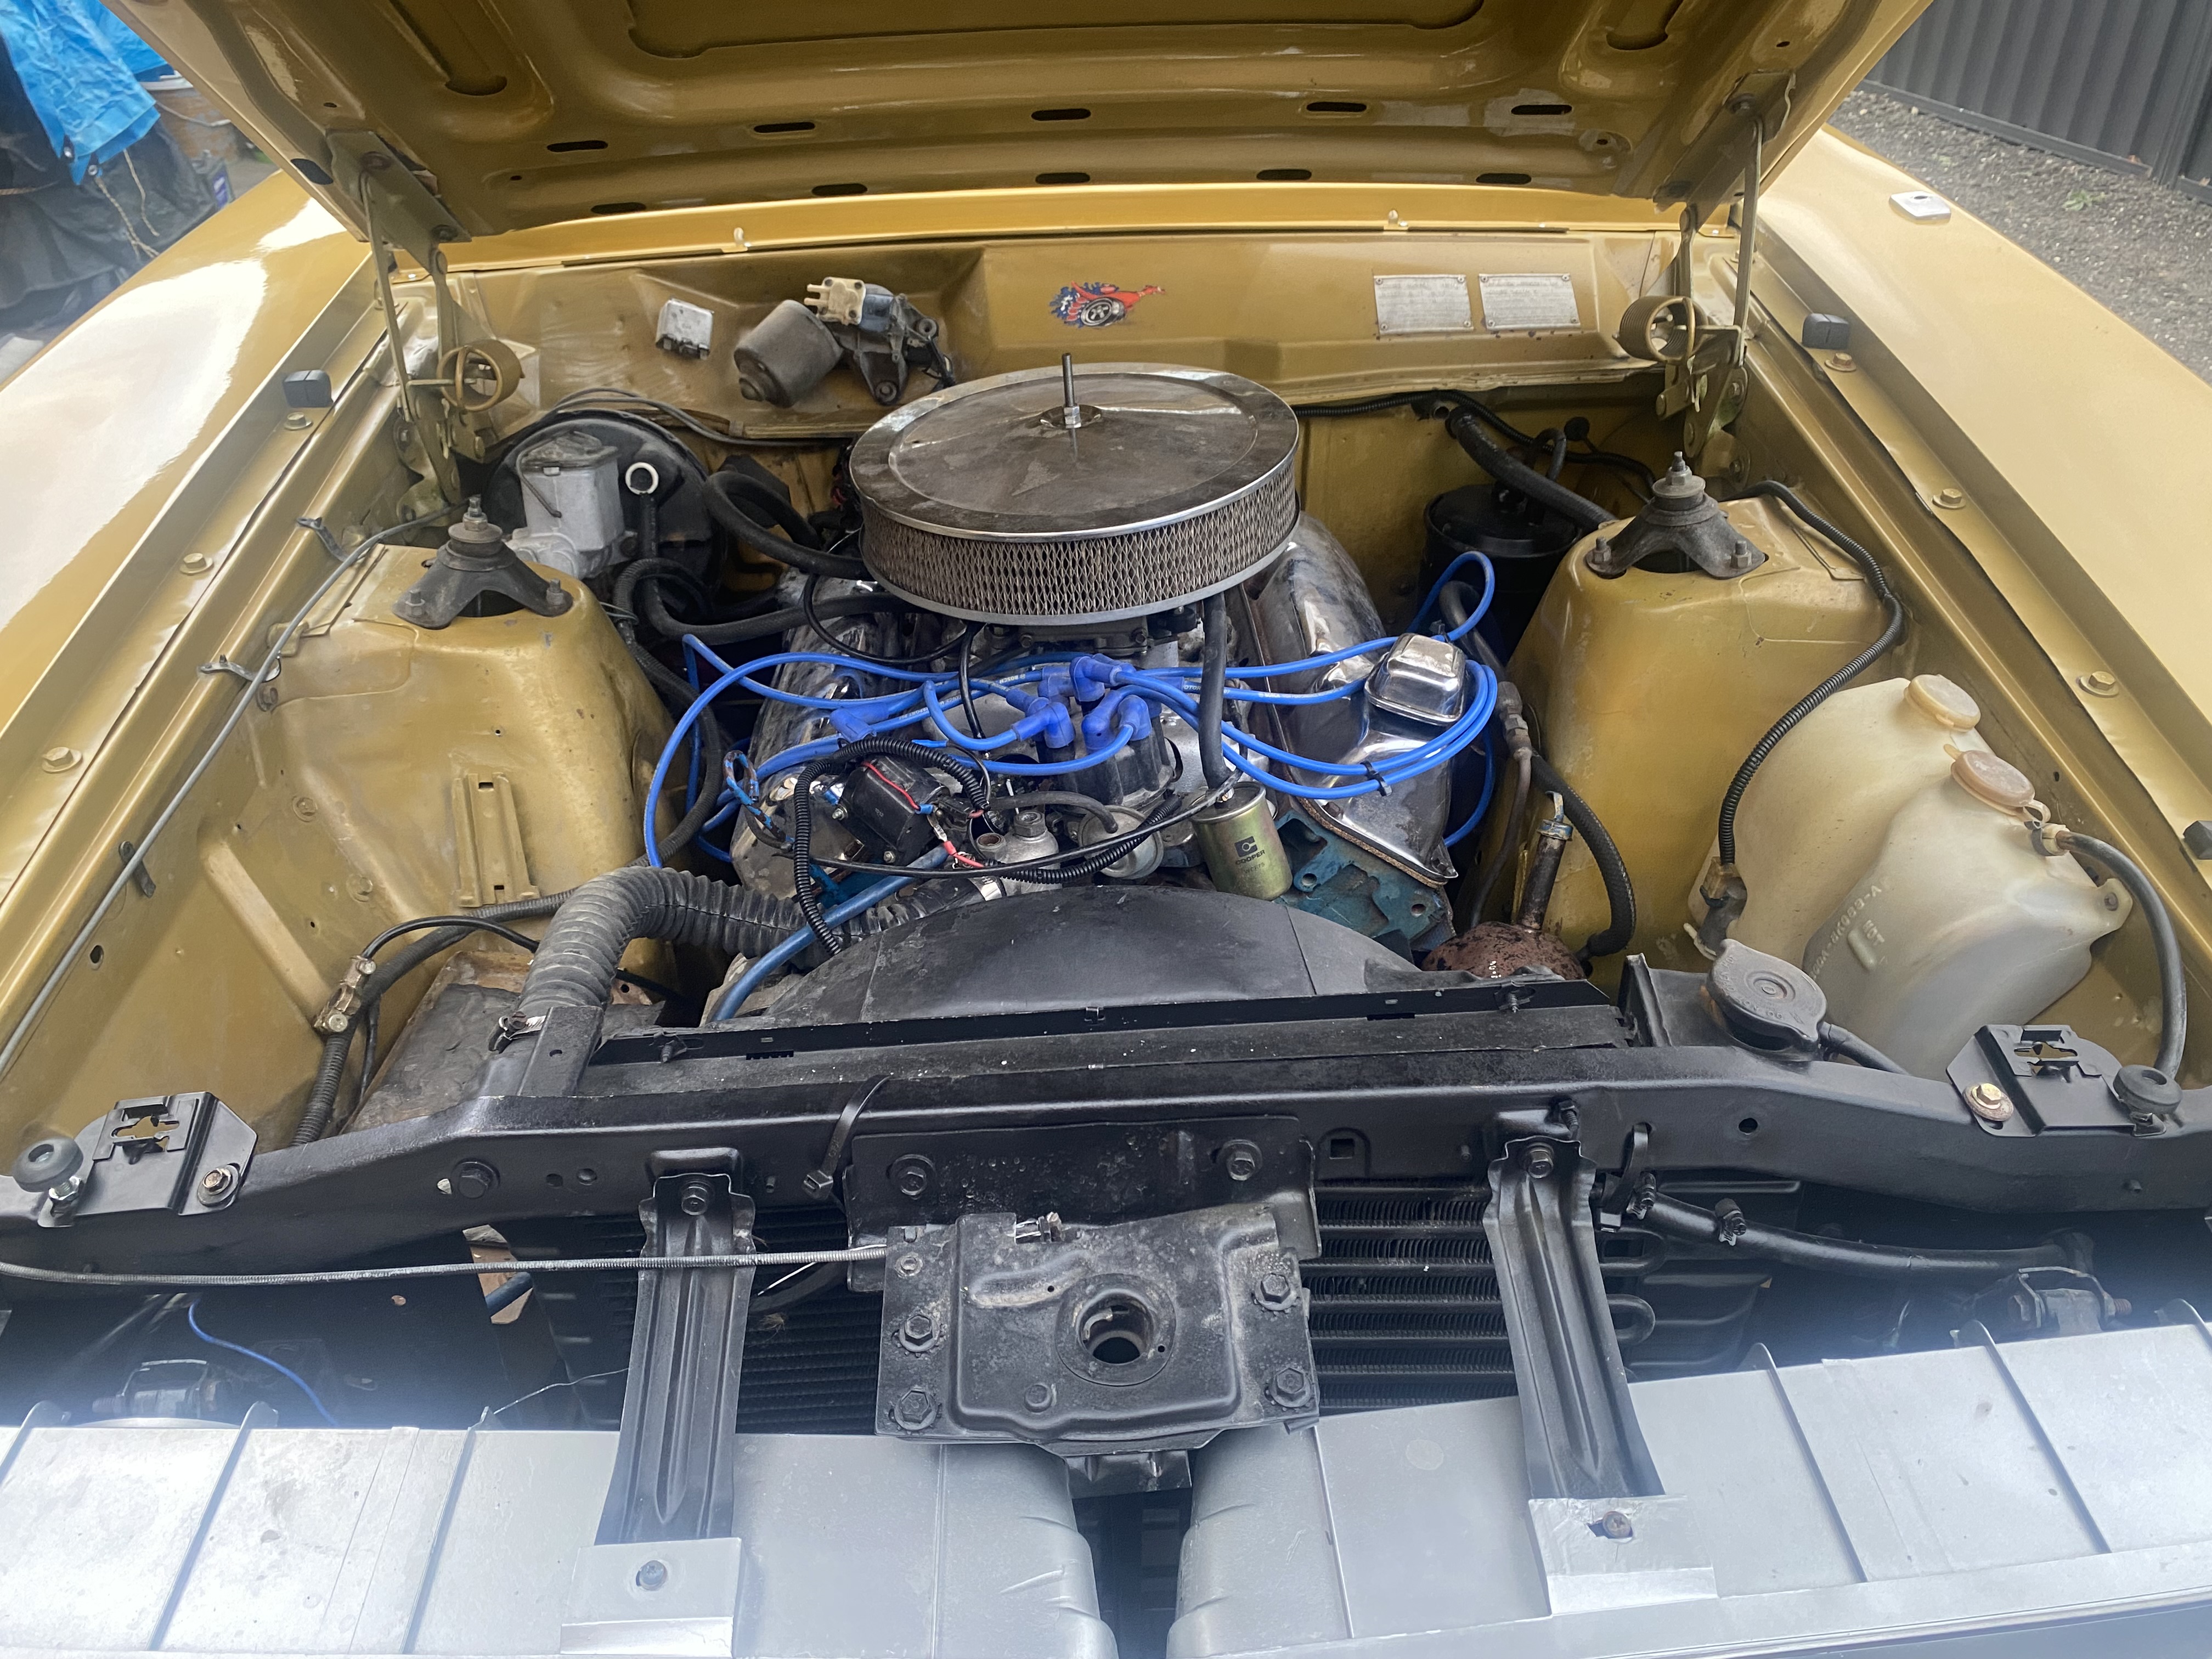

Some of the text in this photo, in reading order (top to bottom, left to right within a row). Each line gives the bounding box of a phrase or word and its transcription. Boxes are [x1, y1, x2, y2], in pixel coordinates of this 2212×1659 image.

[1000, 675, 1019, 684] BOSCH
[1235, 850, 1265, 865] COOPER
[1863, 919, 1885, 946] HOT
